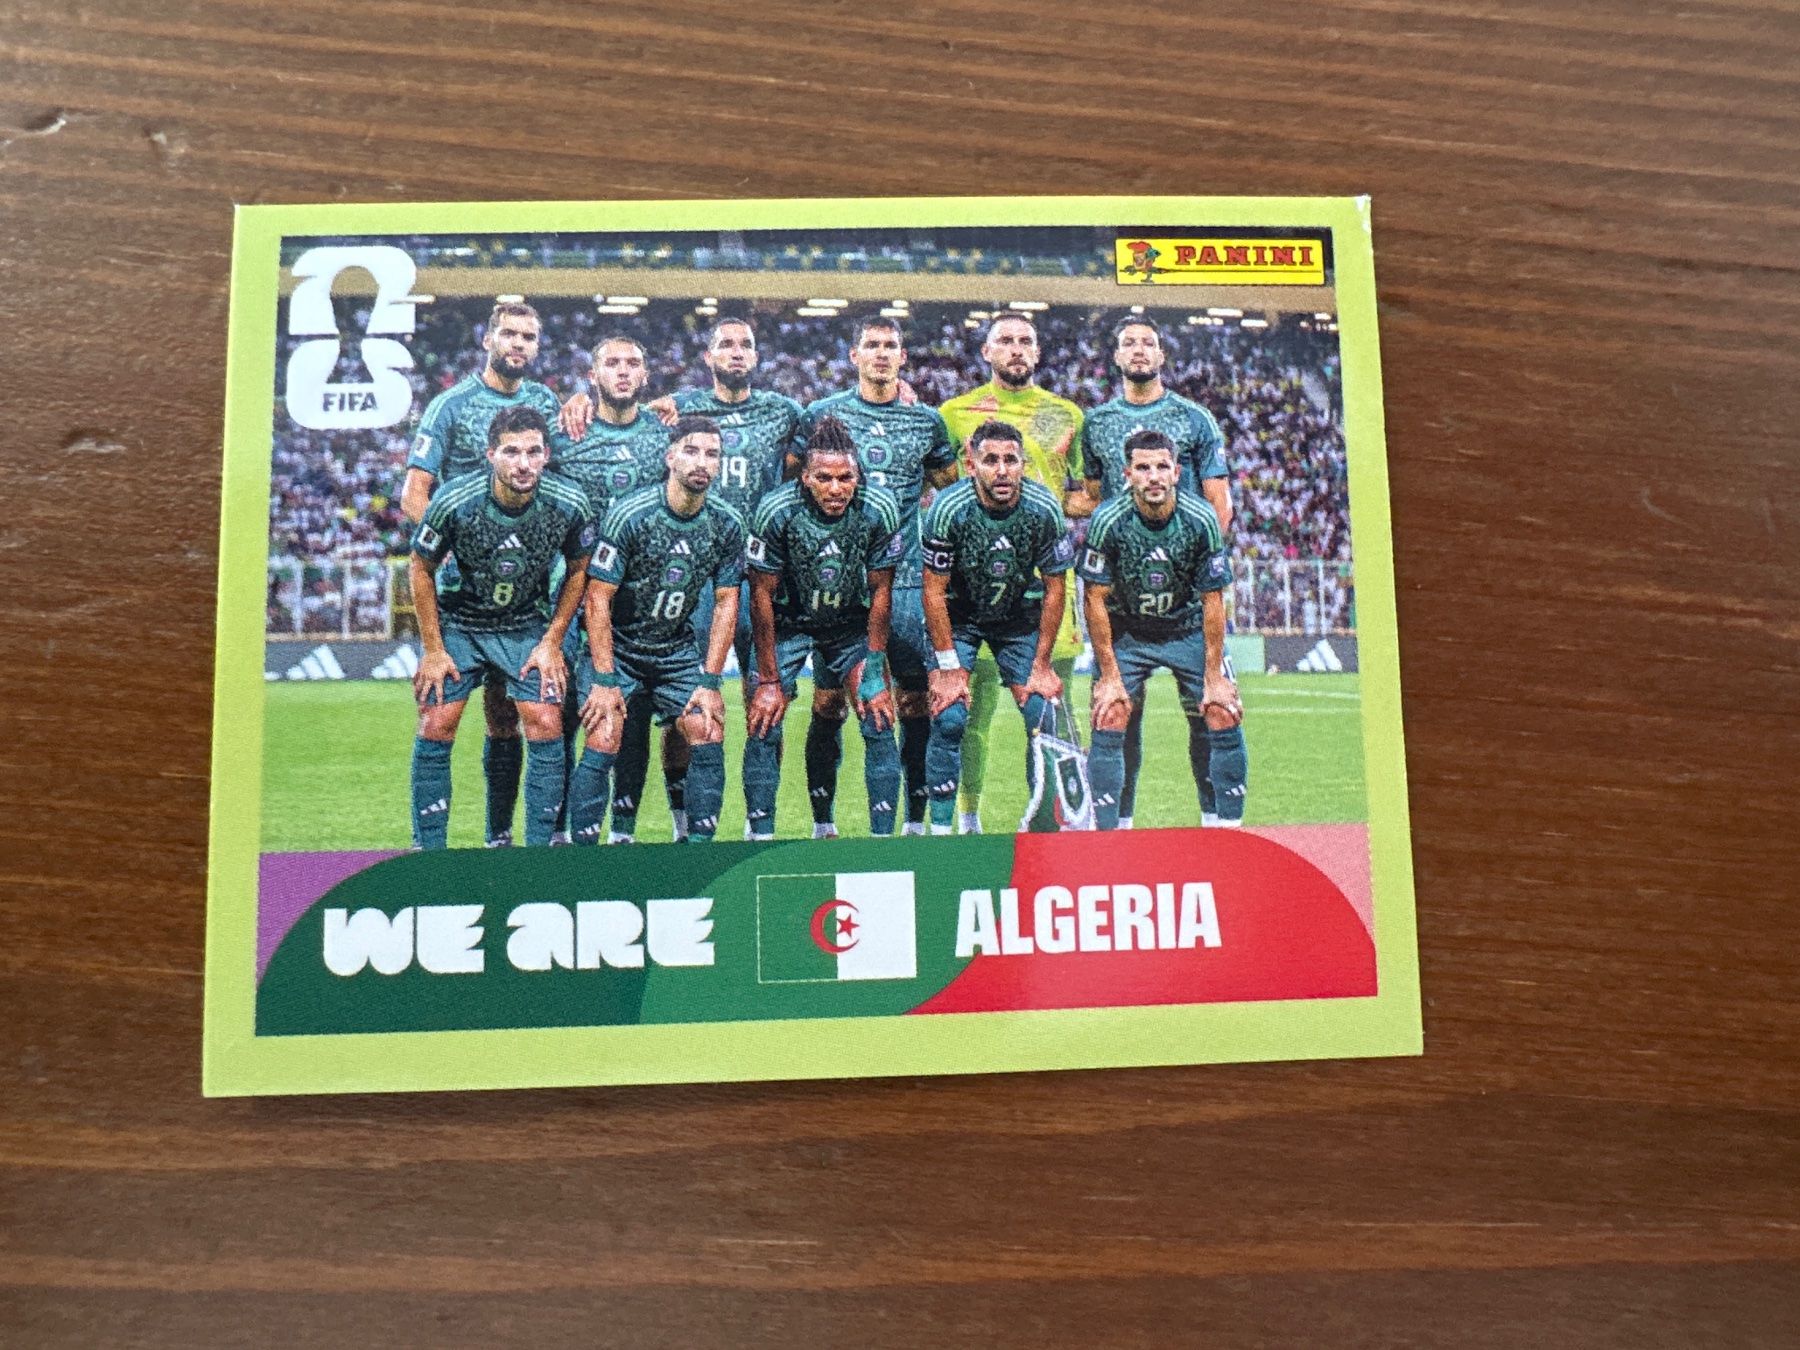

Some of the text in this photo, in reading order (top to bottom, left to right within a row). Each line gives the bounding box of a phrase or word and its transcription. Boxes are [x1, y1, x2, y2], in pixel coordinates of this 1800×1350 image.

[1174, 245, 1314, 266] PANINI
[322, 391, 378, 412] FIFA
[721, 456, 747, 488] 19
[934, 552, 948, 569] C
[492, 582, 514, 606] 8
[651, 590, 685, 619] 18
[812, 589, 841, 610] 14
[990, 582, 1007, 606] 7
[1138, 592, 1174, 615] 20
[955, 881, 1222, 957] ALGERIA
[322, 898, 715, 977] WE ARE
